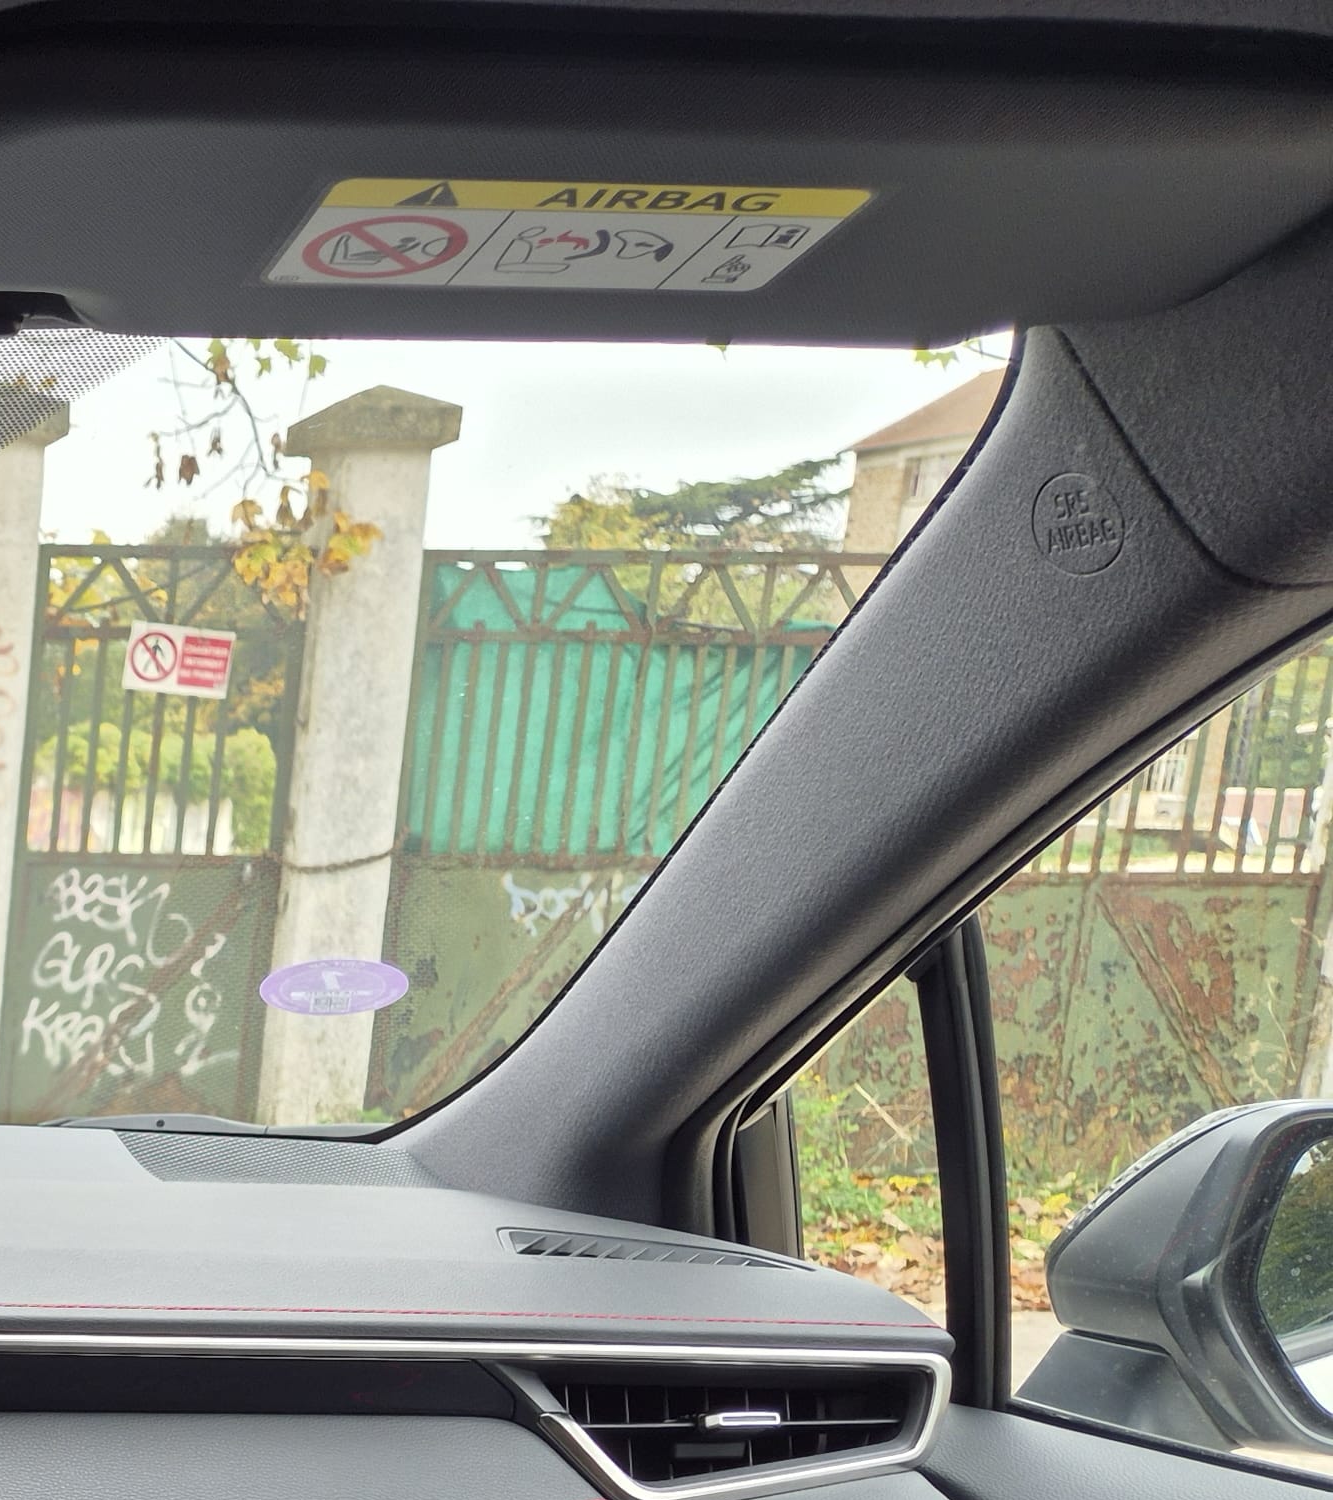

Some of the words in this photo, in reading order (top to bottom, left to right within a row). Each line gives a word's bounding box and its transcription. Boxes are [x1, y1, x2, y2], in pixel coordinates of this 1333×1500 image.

[535, 186, 782, 212] AIRBAG
[1053, 490, 1090, 519] SRS
[1048, 518, 1118, 554] AIRBAG
